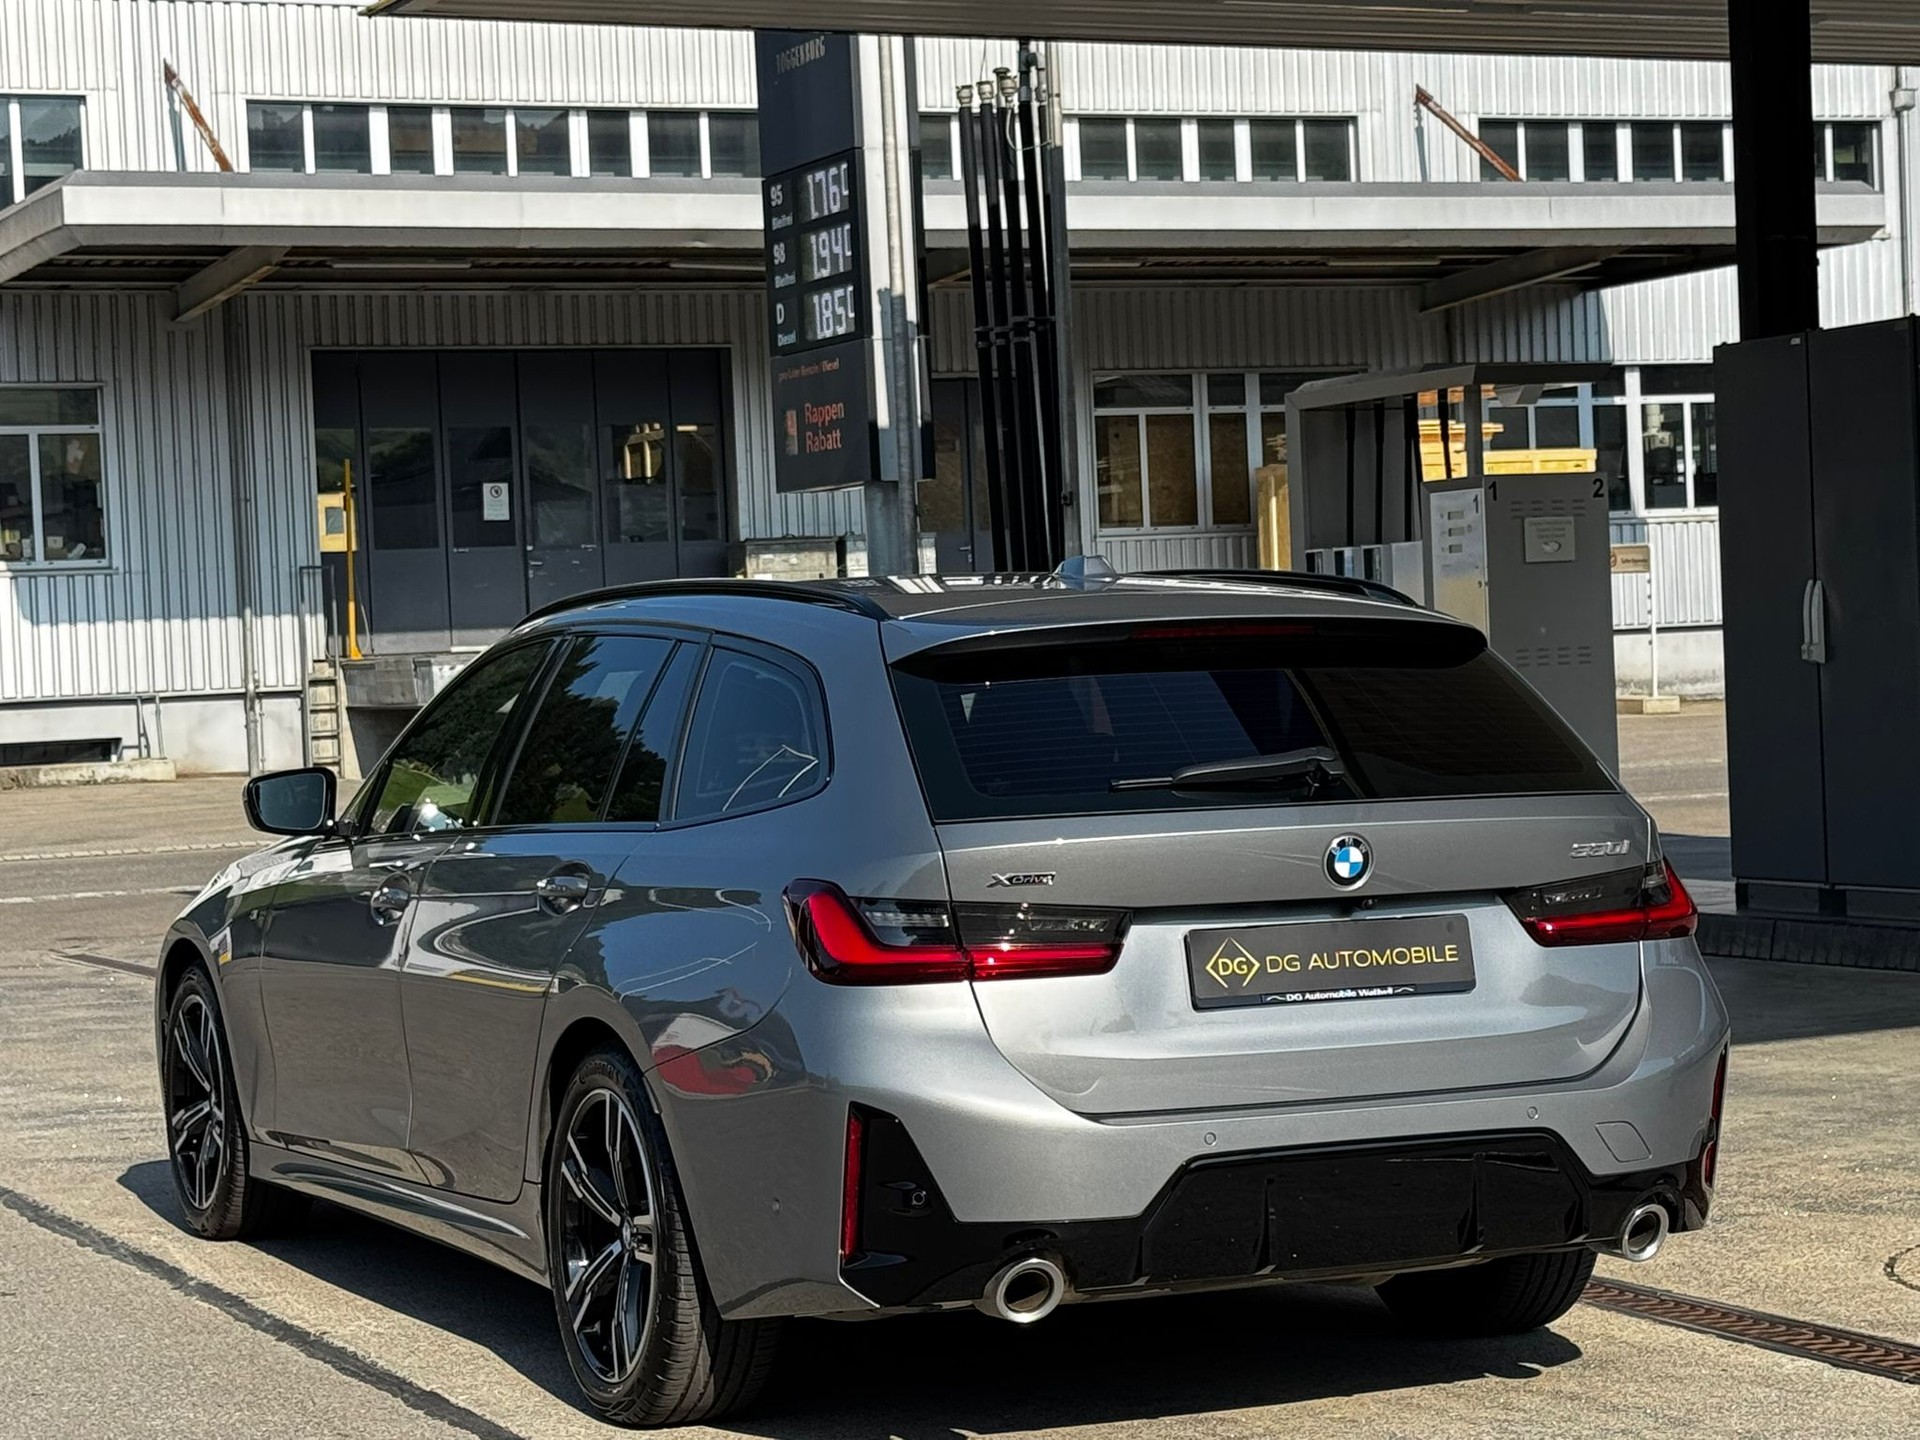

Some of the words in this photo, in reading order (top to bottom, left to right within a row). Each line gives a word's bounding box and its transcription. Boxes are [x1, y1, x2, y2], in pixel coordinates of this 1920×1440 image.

[770, 184, 783, 207] 95
[773, 242, 786, 265] 98
[776, 303, 785, 325] D
[777, 330, 796, 347] Diesel
[804, 402, 845, 428] Rappen
[805, 428, 842, 454] Rabatt
[1489, 480, 1498, 501] 1
[1592, 478, 1605, 498] 2
[1473, 494, 1480, 514] 1
[1218, 957, 1248, 976] DG
[1265, 954, 1301, 974] DG
[1308, 944, 1460, 971] AUTOMOBILE
[1285, 993, 1303, 1003] DG
[1304, 988, 1357, 1001] Automobile
